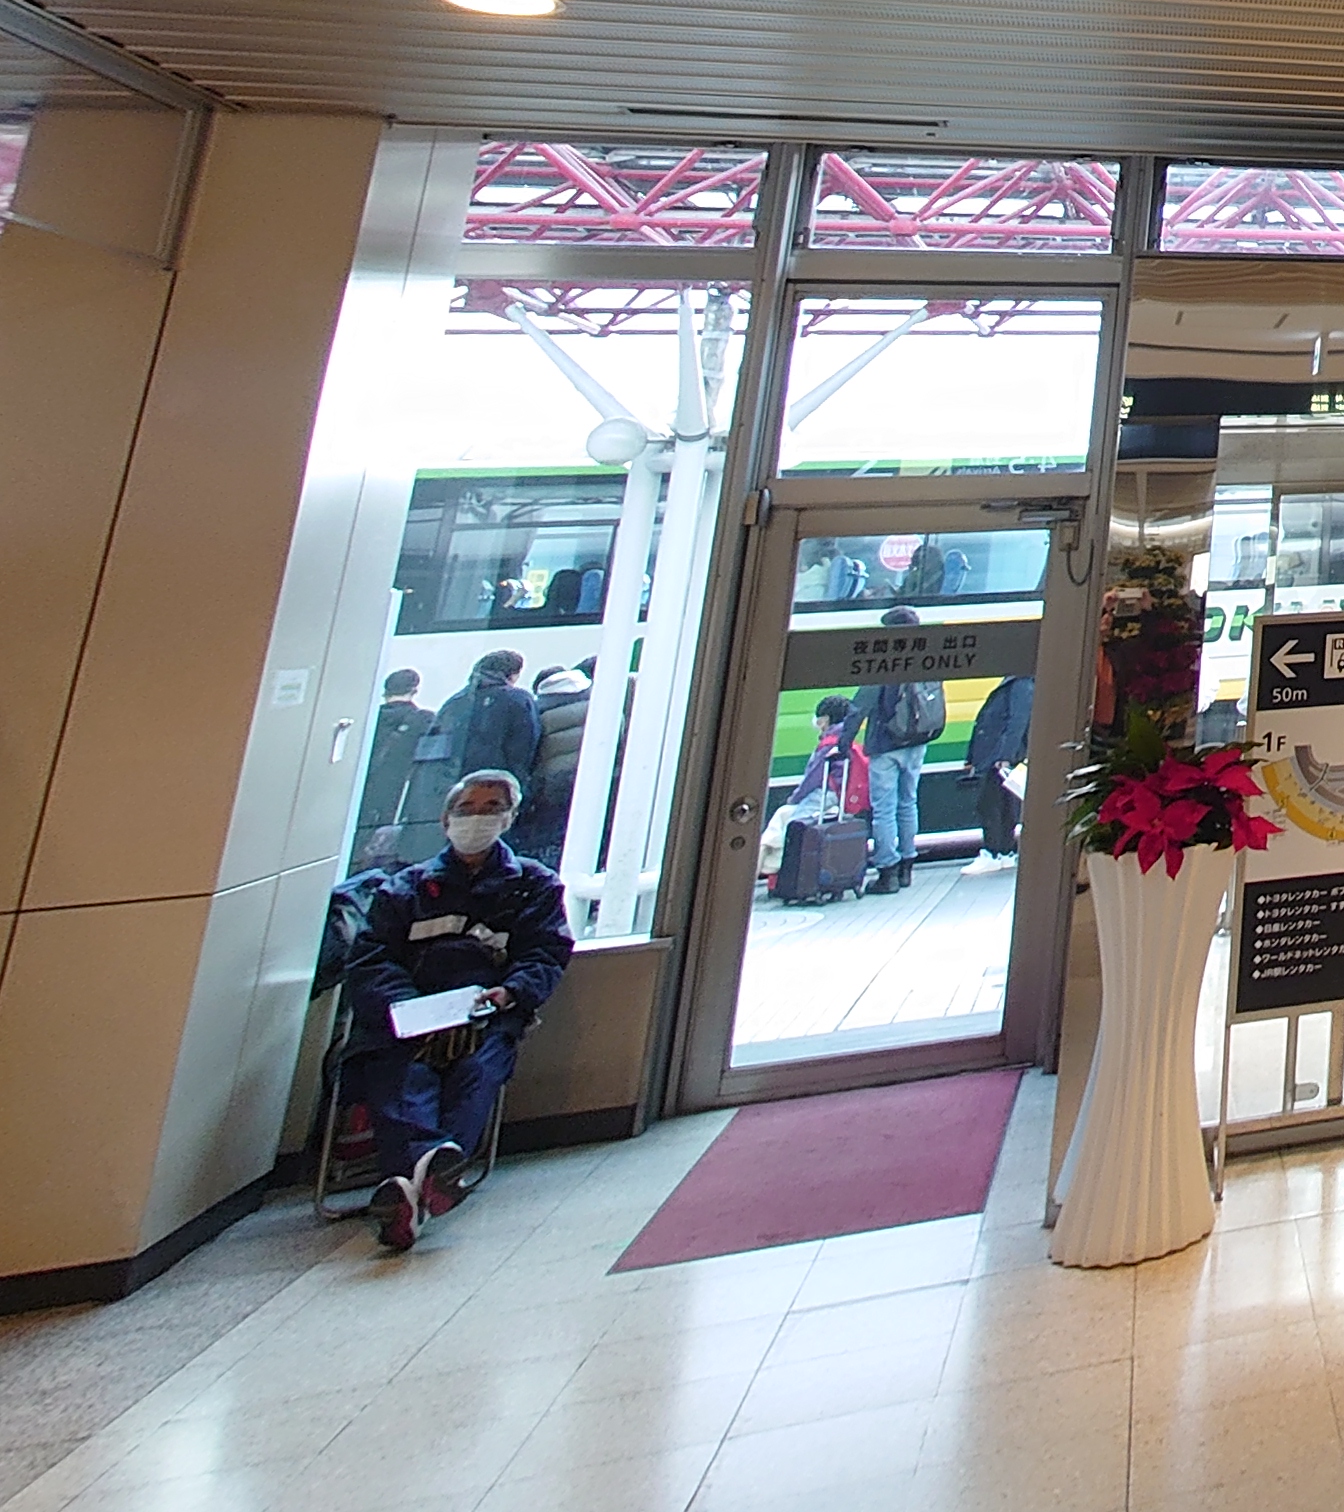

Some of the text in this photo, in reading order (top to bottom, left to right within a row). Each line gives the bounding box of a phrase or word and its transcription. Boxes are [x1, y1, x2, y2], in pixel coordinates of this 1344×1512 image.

[942, 635, 977, 649] 出口
[850, 652, 976, 675] STAFF ONLY
[1272, 687, 1308, 704] 50m
[1262, 731, 1287, 753] 1F
[1265, 889, 1328, 904] トヨタレンタカー
[1264, 904, 1327, 918] トヨタレンタカー
